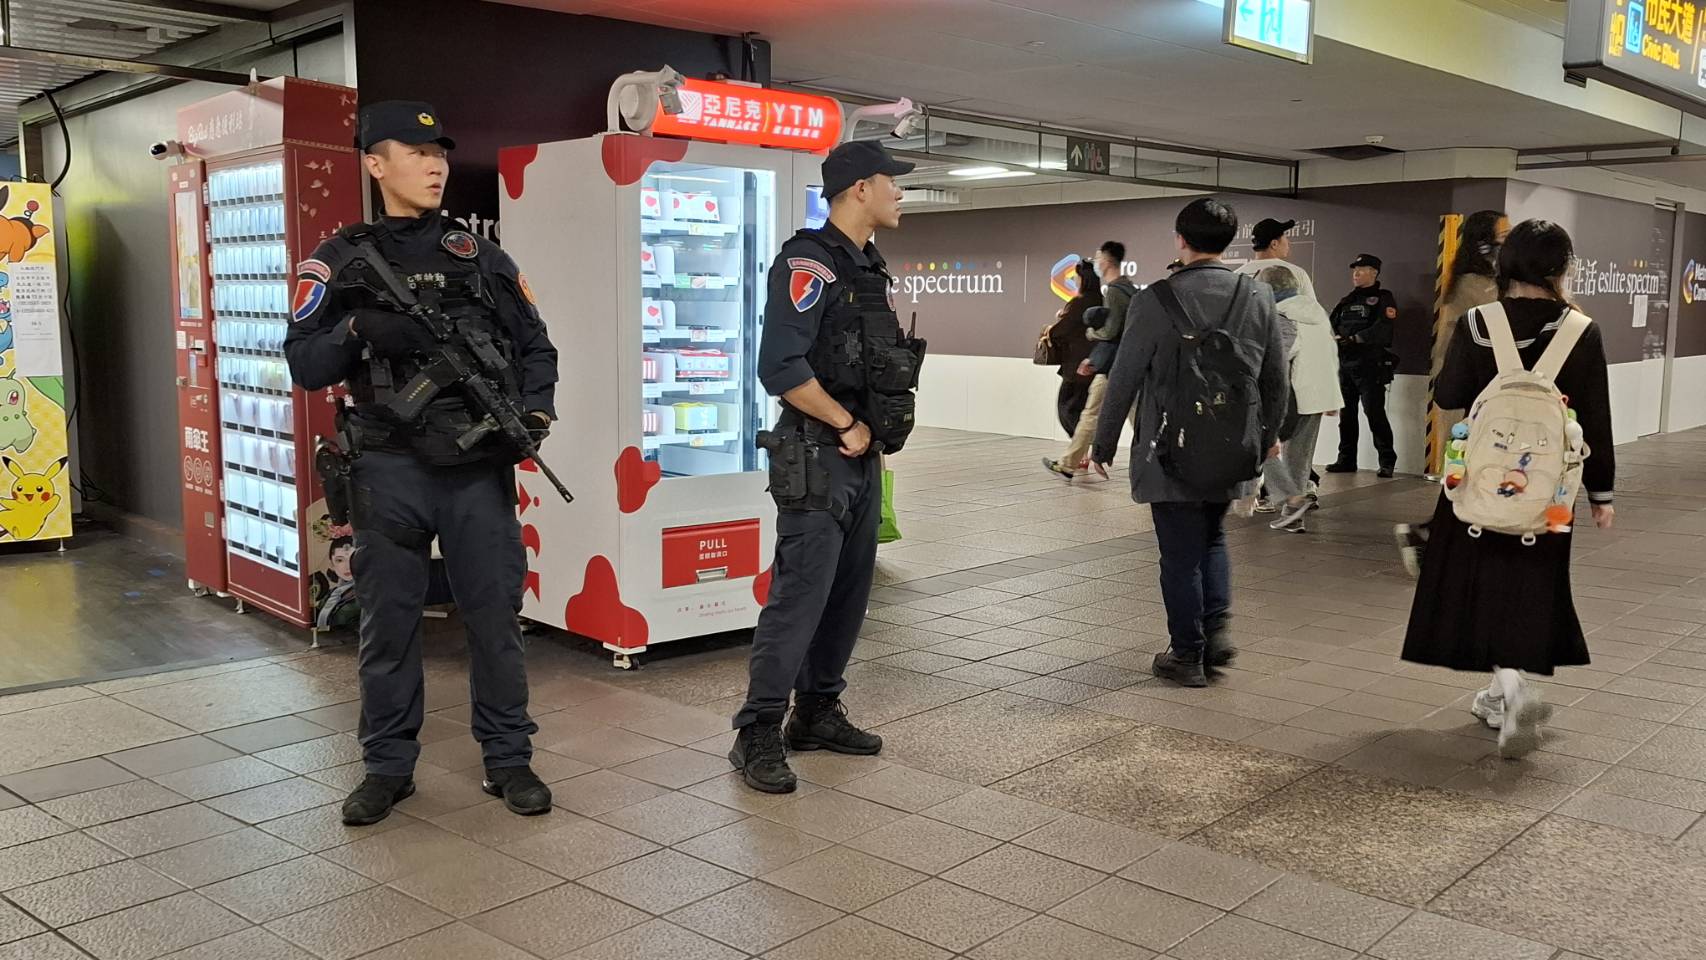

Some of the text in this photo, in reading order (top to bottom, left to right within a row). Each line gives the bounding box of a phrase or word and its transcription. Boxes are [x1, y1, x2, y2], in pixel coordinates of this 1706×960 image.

[704, 94, 761, 119] 亞尼克
[772, 102, 823, 127] YTM
[904, 273, 1003, 303] spectrum
[1598, 262, 1626, 294] eslite
[184, 426, 209, 453] 雨傘王
[699, 539, 727, 550] PULL
